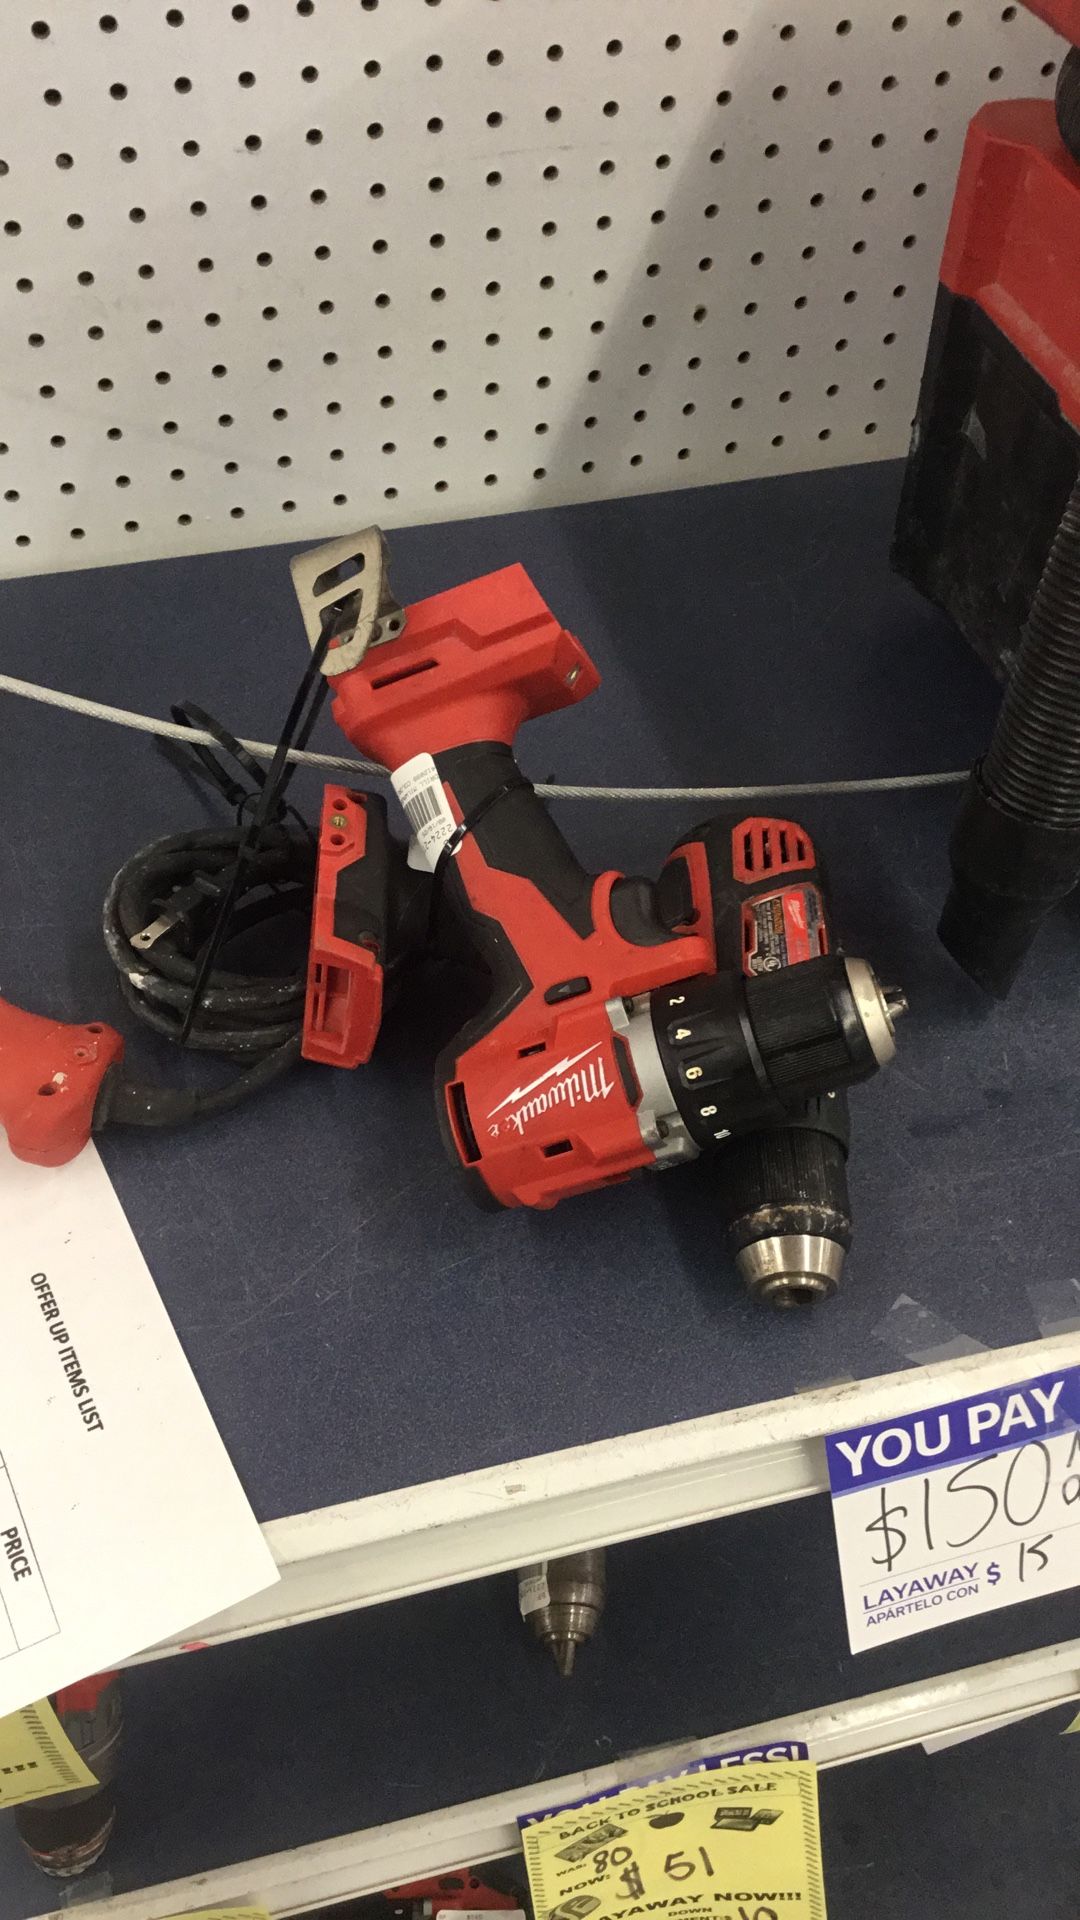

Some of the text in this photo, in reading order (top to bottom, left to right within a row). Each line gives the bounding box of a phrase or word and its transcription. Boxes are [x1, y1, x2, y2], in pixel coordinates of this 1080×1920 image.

[669, 996, 686, 1006] 2
[675, 1028, 692, 1040] 4
[685, 1066, 703, 1080] 6
[488, 1056, 615, 1139] Milwauke
[700, 1104, 718, 1117] 8
[30, 1272, 104, 1432] OFFER UP ITEMS LIST
[835, 1381, 1065, 1477] YOU PAY
[1, 1526, 32, 1582] PRICE
[863, 1562, 979, 1610] LAYAWAY
[986, 1562, 1002, 1585] $
[865, 1583, 979, 1627] APÁRTELO CON
[559, 1816, 611, 1840] BACK
[616, 1807, 641, 1821] TO
[645, 1787, 723, 1813] SCHOOL
[727, 1781, 778, 1796] SALE
[593, 1846, 633, 1873] 80
[559, 1873, 611, 1896] NOW:
[598, 1893, 704, 1920] AYAWAY
[668, 1907, 713, 1918] DOWN
